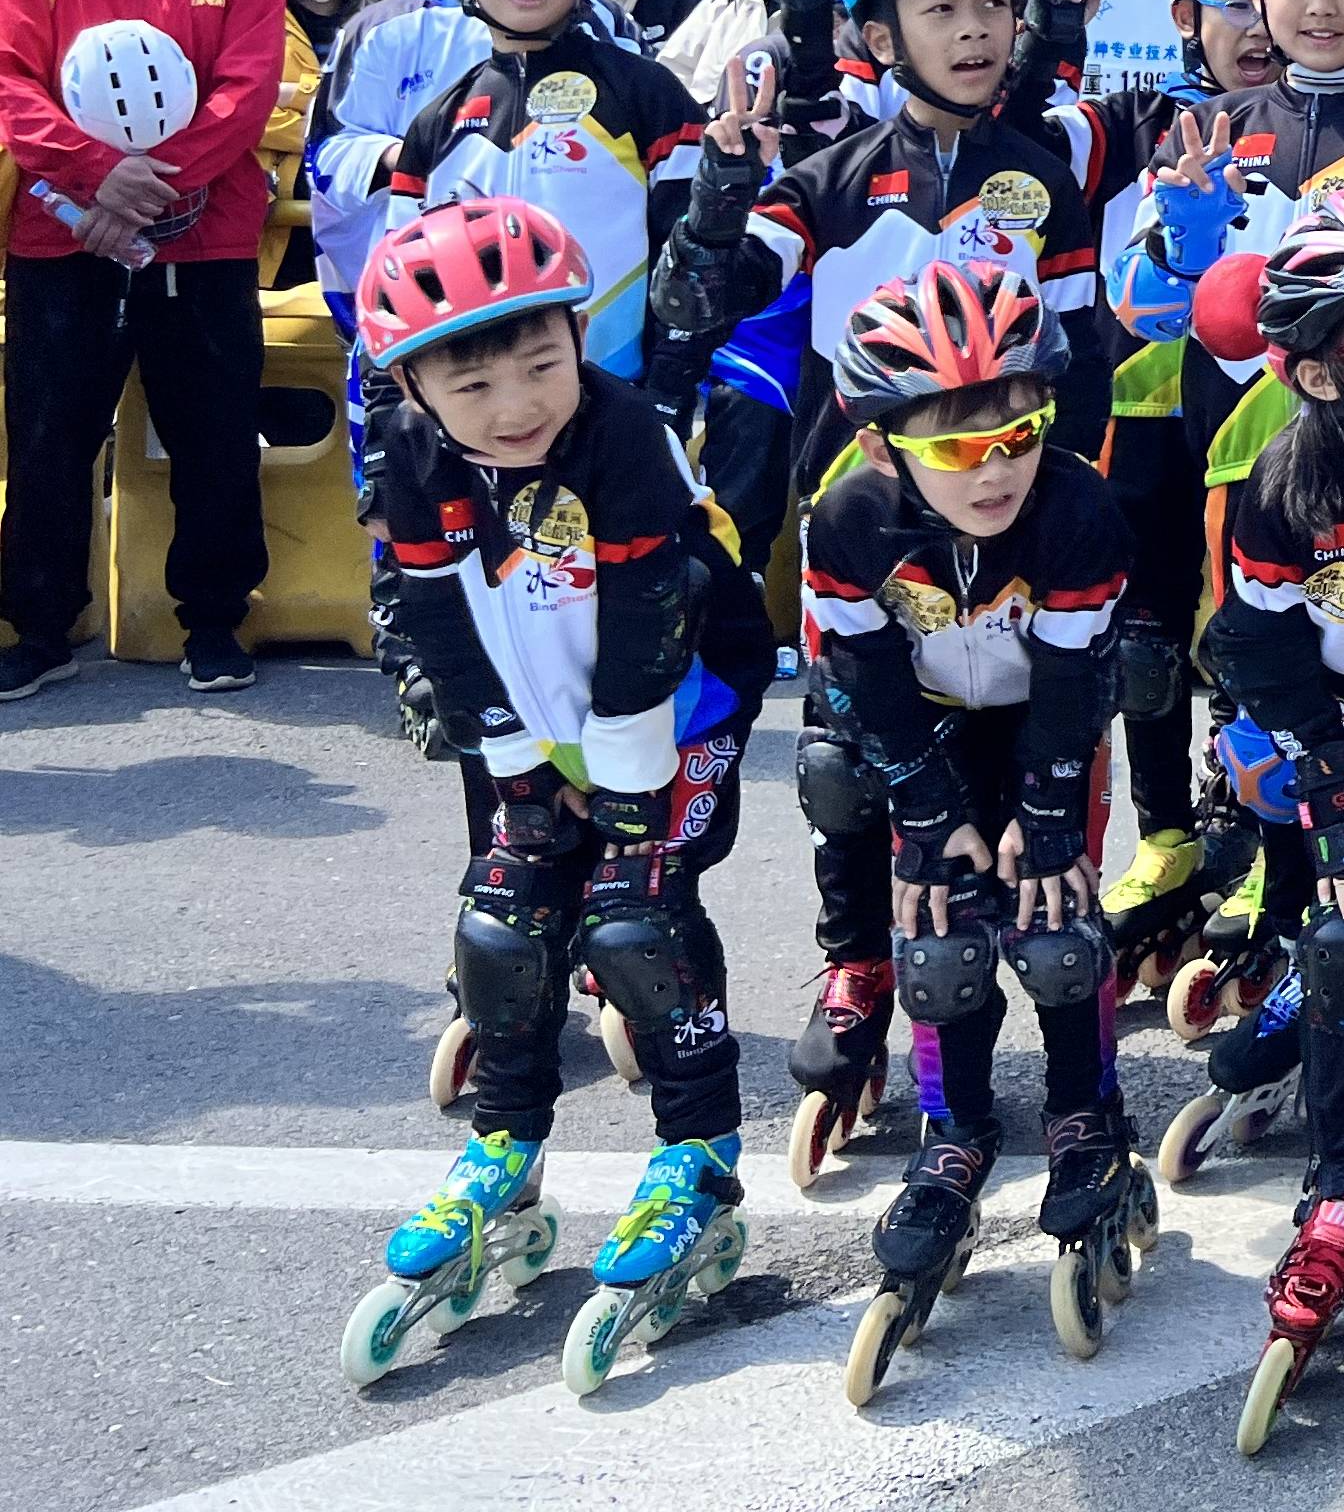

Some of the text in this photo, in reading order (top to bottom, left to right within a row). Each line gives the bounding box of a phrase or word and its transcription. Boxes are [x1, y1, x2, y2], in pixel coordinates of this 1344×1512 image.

[1231, 155, 1271, 168] CHINA
[867, 193, 909, 207] CHINA
[444, 528, 474, 542] CHI
